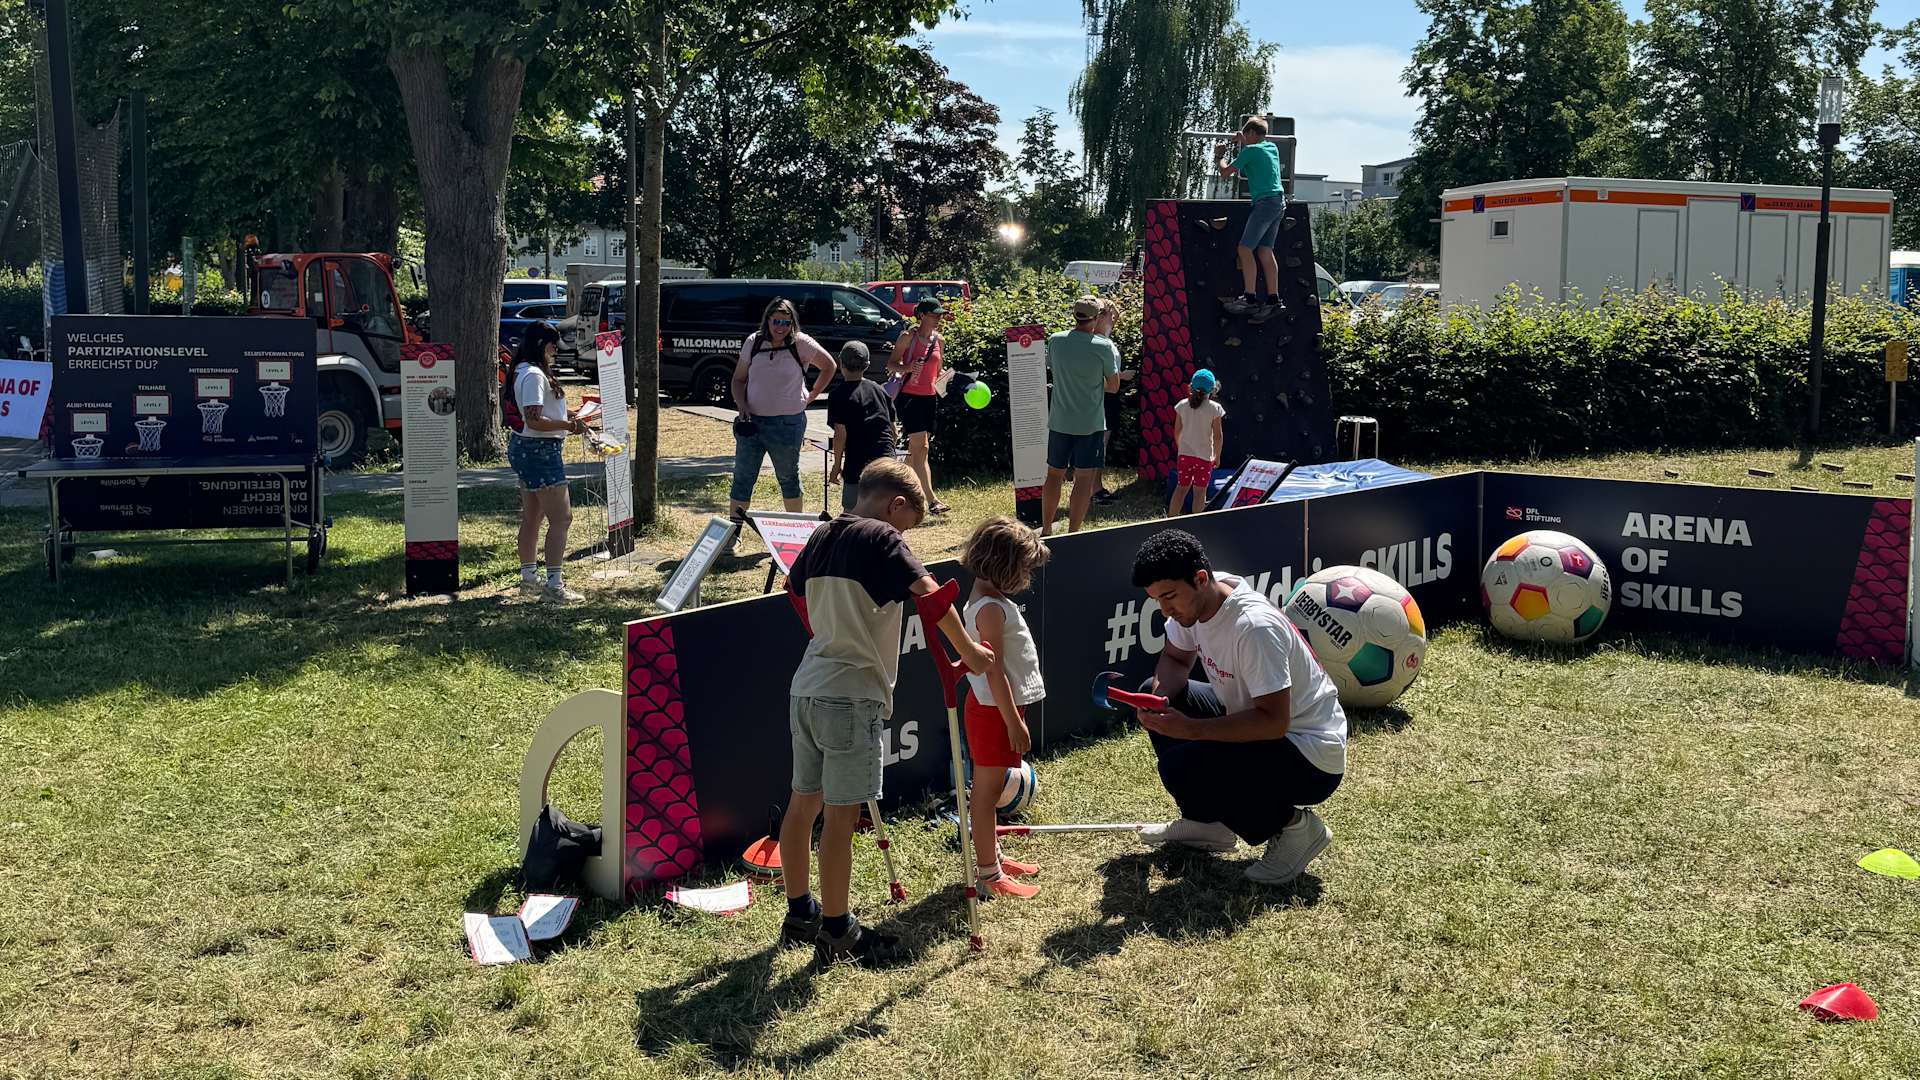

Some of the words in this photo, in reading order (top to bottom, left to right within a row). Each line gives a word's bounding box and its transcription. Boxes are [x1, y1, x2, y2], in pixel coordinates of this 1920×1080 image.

[67, 333, 124, 343] WELCHES
[672, 338, 742, 348] TAILORMADE
[68, 347, 208, 357] PARTIZIPATIONSLEVEL
[68, 360, 132, 369] ERREICHST
[135, 360, 158, 370] DU?
[18, 379, 41, 396] OF
[199, 480, 281, 490] BETEILIGUNG.
[242, 493, 280, 502] RECHT
[223, 506, 262, 515] HABEN
[1526, 507, 1540, 515] DFL
[1525, 514, 1562, 524] STIFTUNG
[1621, 512, 1752, 546] ARENA
[1621, 546, 1669, 575] OF
[1620, 581, 1743, 618] SKILLS
[1295, 590, 1353, 647] DERBYSTAR
